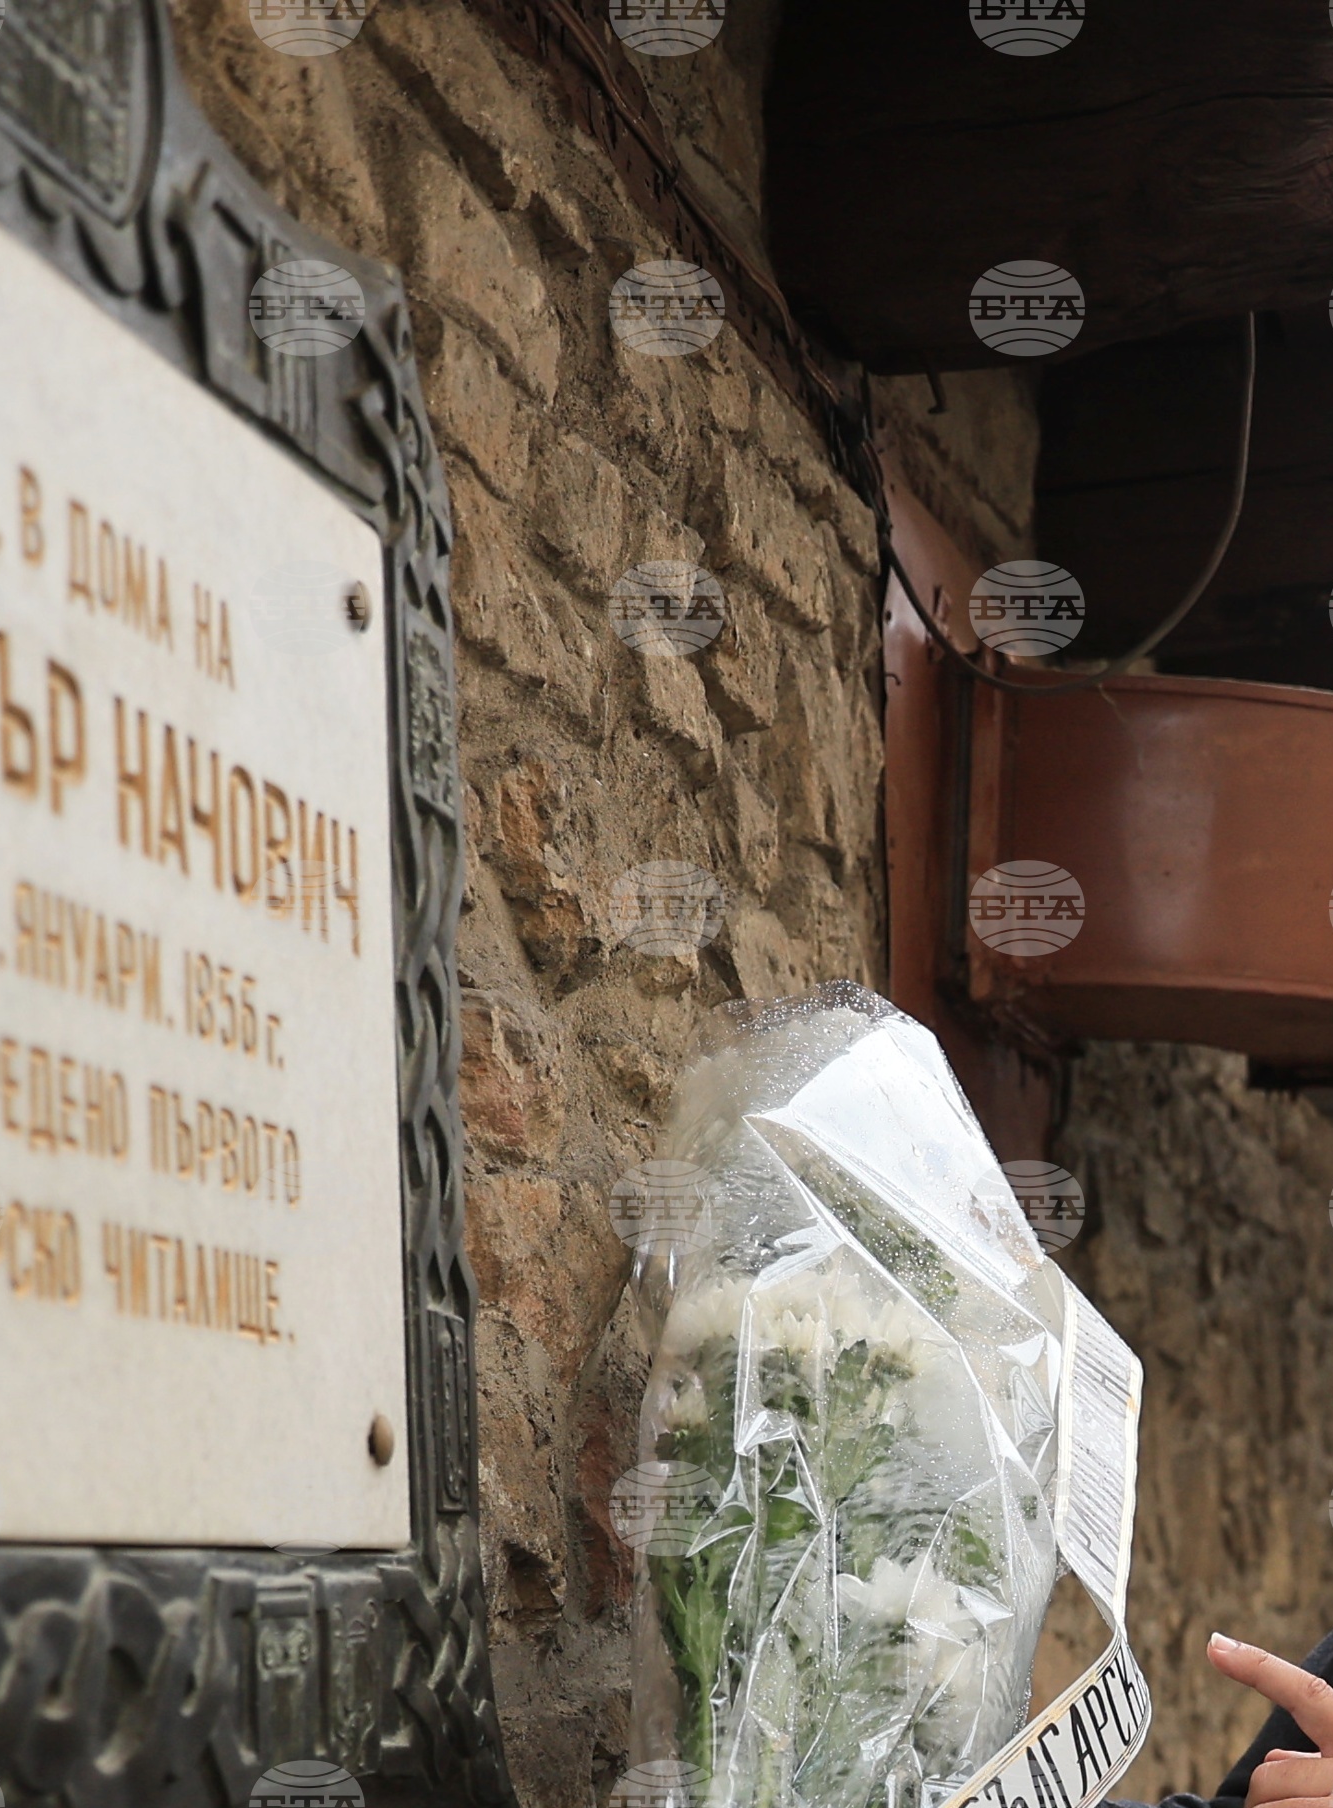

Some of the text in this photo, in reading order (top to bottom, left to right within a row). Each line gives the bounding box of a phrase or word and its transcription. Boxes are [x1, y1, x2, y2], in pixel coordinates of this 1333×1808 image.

[19, 462, 44, 568] В
[68, 497, 175, 654] ДОМА
[192, 581, 236, 691] НА
[113, 693, 361, 958] НАЧОВИЧ
[149, 1083, 301, 1208] ПЪРВОТО
